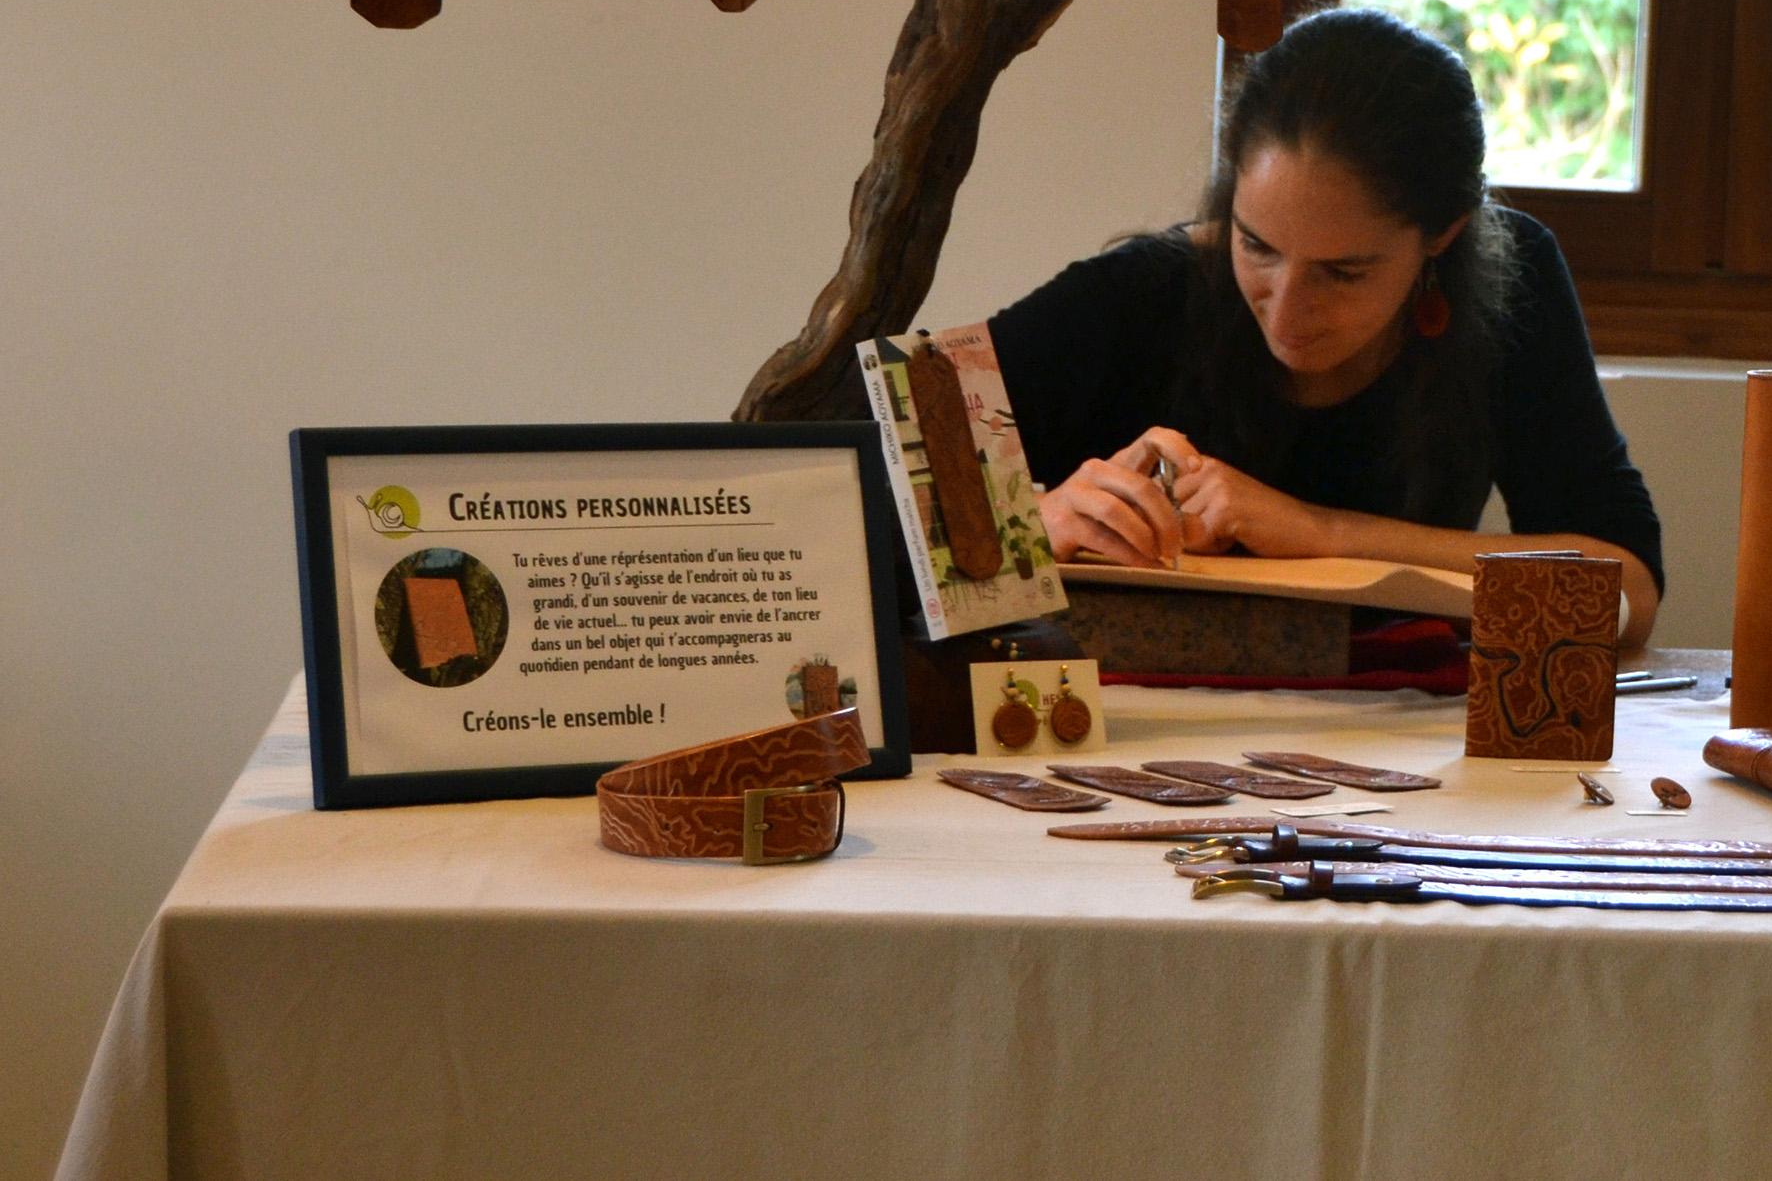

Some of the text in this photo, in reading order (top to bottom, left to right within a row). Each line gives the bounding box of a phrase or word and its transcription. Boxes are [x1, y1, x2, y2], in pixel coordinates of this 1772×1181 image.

[448, 487, 752, 522] CRÉATIONS PERSONNALISÉES
[511, 547, 803, 569] Tu rêves d'une réprésentation d'un lieu que tu
[527, 567, 793, 590] aimes ? Qu'il s'agisse de l'endroit où tu as
[532, 586, 819, 614] grandi, d'un souvenir de vacances, de ton lieu
[533, 615, 550, 631] de
[553, 614, 574, 630] vie
[630, 614, 646, 628] tu
[648, 614, 681, 631] peux
[684, 609, 716, 626] avoir
[719, 608, 754, 625] envie
[756, 607, 773, 623] de
[774, 607, 822, 622] l'ancrer
[530, 631, 793, 652] dans un bel objet qui t'accompagneras au
[519, 651, 760, 677] quotidien pendant de longues années.
[462, 703, 666, 733] Créons-le ensemble !
